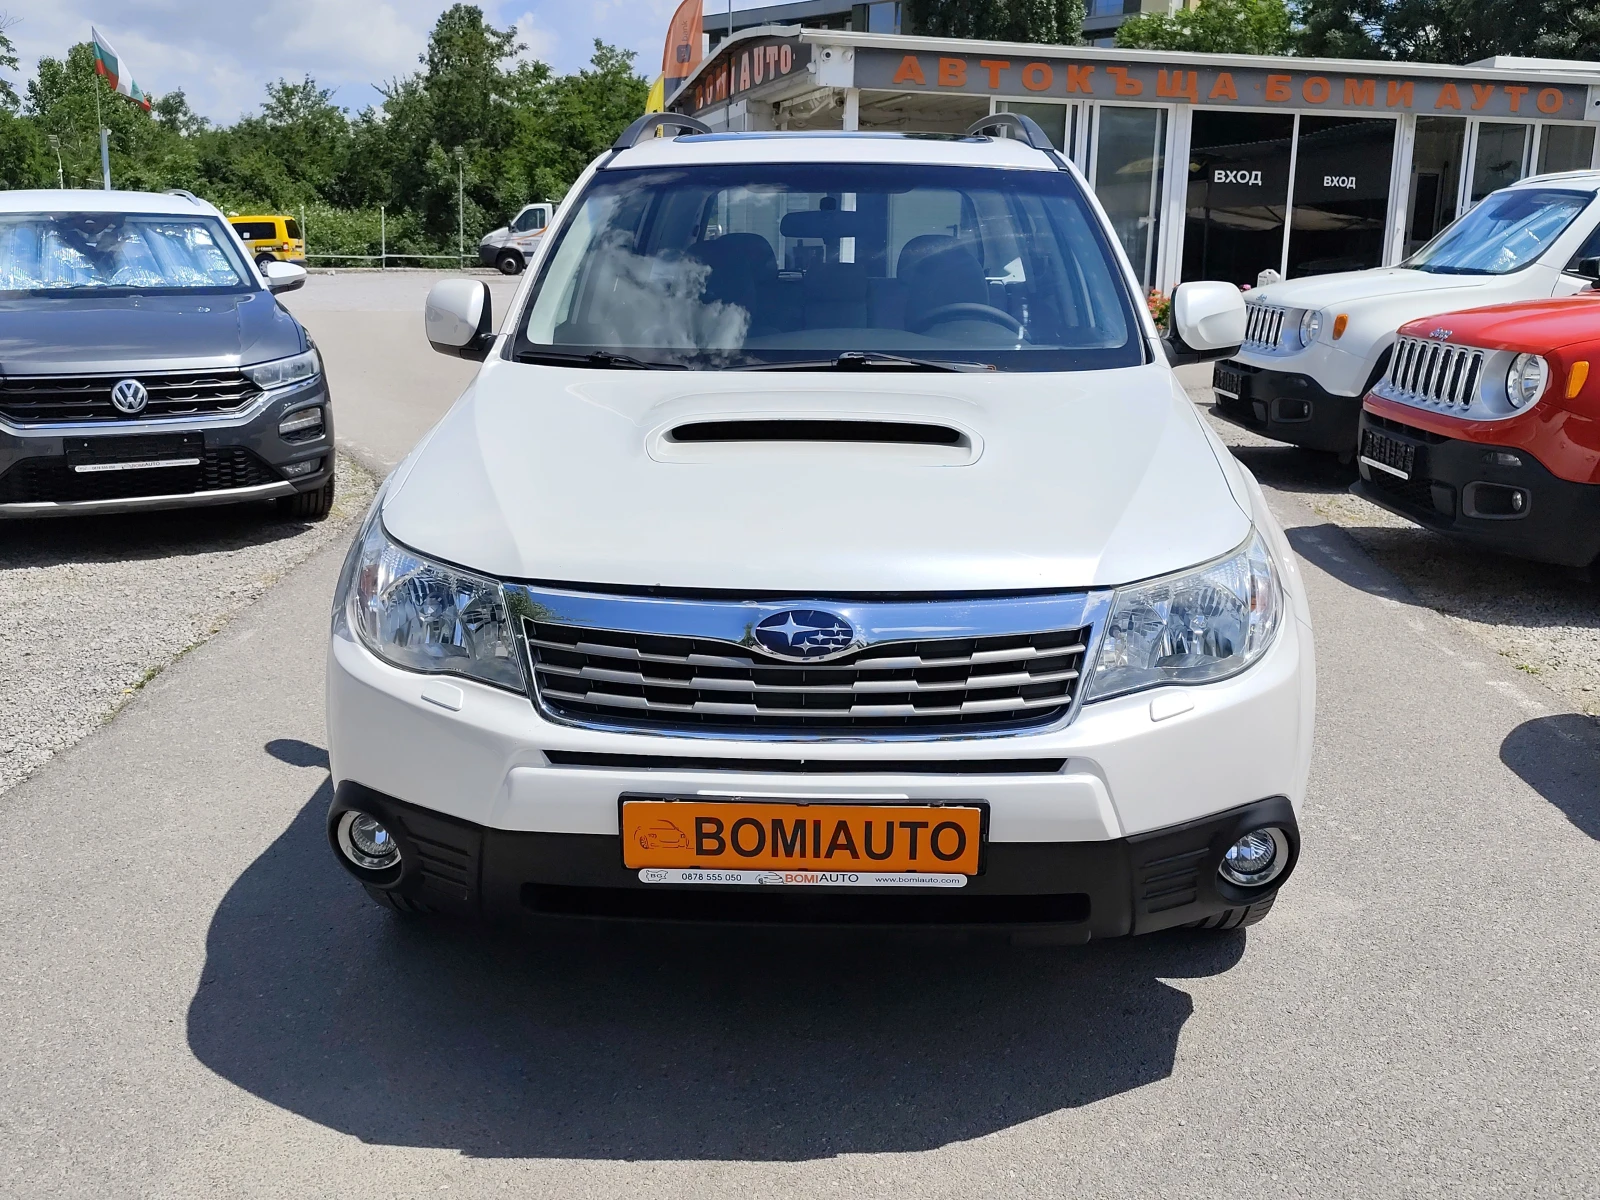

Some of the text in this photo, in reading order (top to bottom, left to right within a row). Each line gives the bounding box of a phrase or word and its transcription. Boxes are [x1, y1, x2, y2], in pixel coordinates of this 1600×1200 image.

[892, 55, 1564, 114] АВТОКЪЩА БОМИ АУТО
[1214, 169, 1262, 186] ВХОД
[1323, 175, 1356, 189] ВХОД
[694, 817, 967, 861] BOMIAUTO
[681, 872, 742, 882] 0878 555 050
[785, 873, 859, 883] BOMIAUTO
[874, 876, 960, 884] www.bomiauto.com
